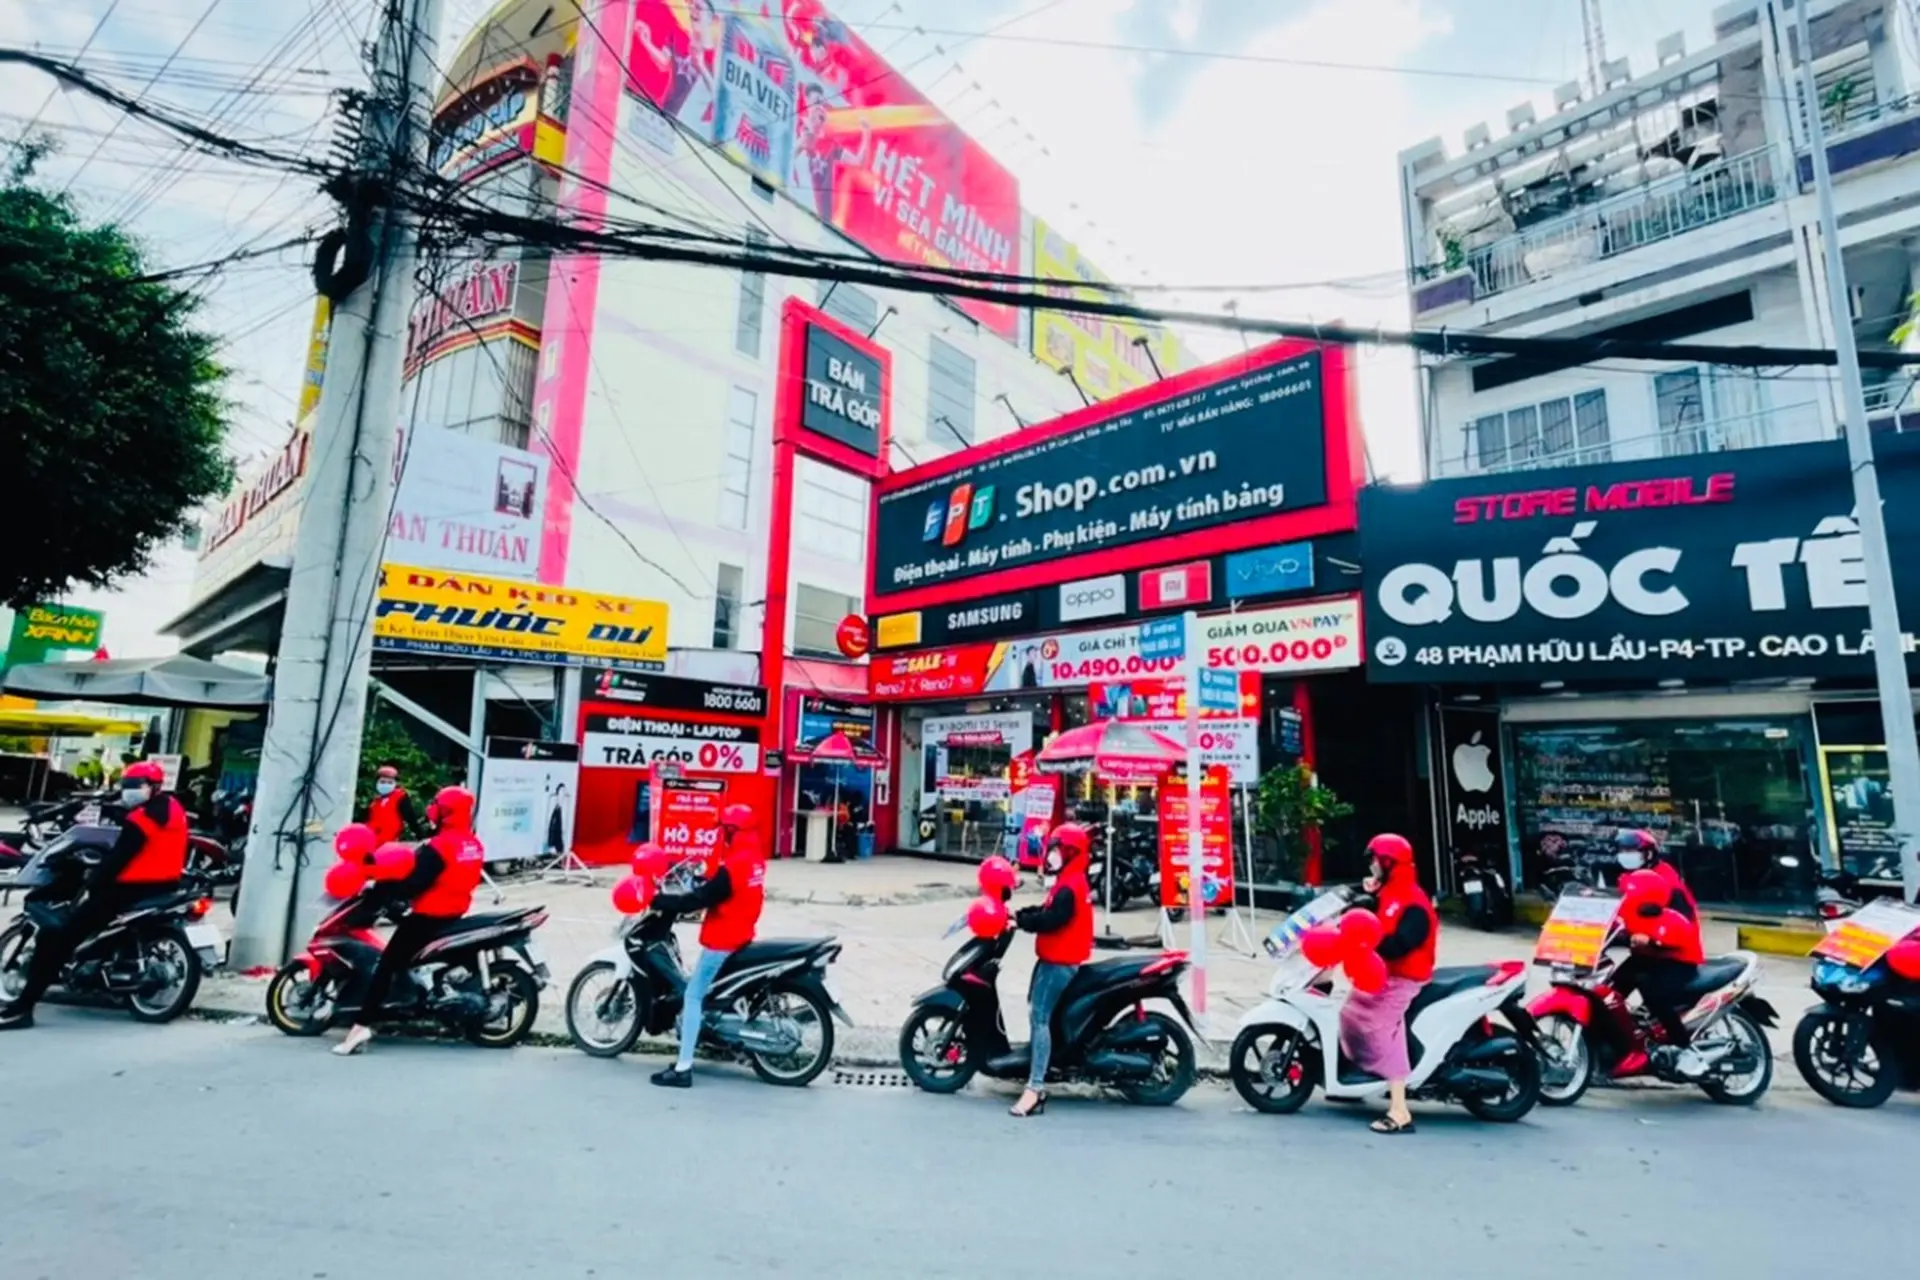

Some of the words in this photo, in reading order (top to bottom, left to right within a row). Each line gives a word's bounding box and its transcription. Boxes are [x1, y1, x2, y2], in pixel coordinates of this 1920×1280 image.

[725, 59, 753, 97] BIA
[872, 139, 937, 210] HẾT
[940, 192, 1012, 270] MÌNH
[896, 200, 932, 240] SEA
[828, 356, 866, 394] BÁN
[846, 399, 882, 431] GÓP
[1453, 487, 1577, 524] STORE
[1585, 472, 1736, 513] MOBILE
[893, 562, 923, 585] Điện
[924, 553, 960, 579] thoại
[967, 546, 999, 569] Máy
[1001, 537, 1032, 561] tính
[1042, 528, 1074, 551] Phụ
[1076, 518, 1118, 544] kiện
[1129, 505, 1173, 531] Máy
[1175, 494, 1220, 521] tính
[1222, 481, 1285, 512] bảng
[1377, 520, 1691, 627] QUỐC
[1730, 499, 1886, 612] TẾ
[947, 602, 1023, 631] SAMSUNG
[1207, 619, 1248, 640] GIẢM
[1252, 619, 1289, 636] QUA
[1289, 612, 1343, 632] VNPAY
[1102, 630, 1127, 650] CHỈ
[1414, 646, 1444, 666] 48
[1447, 644, 1523, 668] PHẠM
[1527, 638, 1584, 662] HỮU
[1758, 633, 1829, 657] CAO
[907, 652, 943, 674] SALE
[703, 692, 732, 710] 1800
[734, 696, 762, 712] 6601
[606, 716, 643, 736] ĐIỆN
[643, 719, 685, 740] THOẠI
[692, 725, 742, 739] LAPTOP
[602, 742, 647, 765] TRẢ
[698, 743, 745, 769] 0%
[1456, 803, 1501, 830] Apple
[663, 821, 690, 843] HỒ
[694, 827, 720, 846] SƠ
